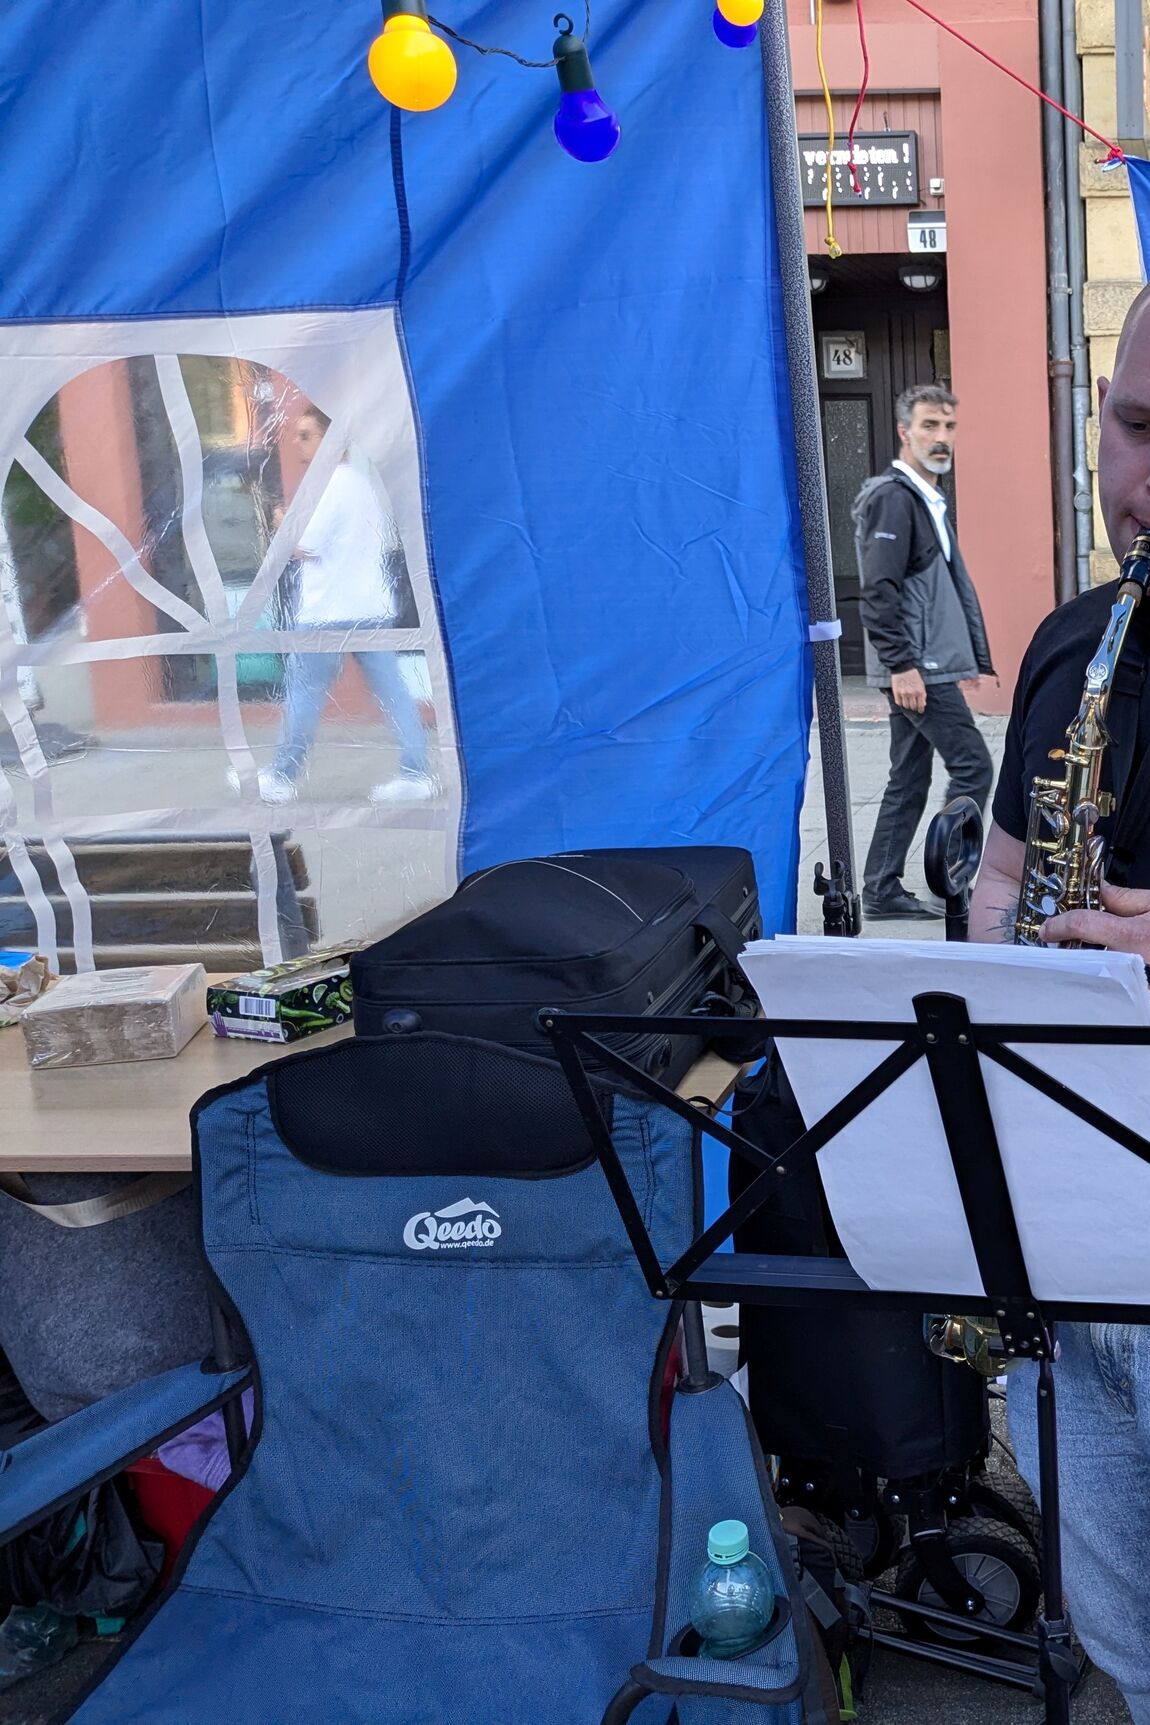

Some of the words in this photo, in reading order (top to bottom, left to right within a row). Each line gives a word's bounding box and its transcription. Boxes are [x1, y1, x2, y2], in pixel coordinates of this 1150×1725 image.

[919, 229, 937, 249] 48
[832, 348, 853, 366] 48
[403, 1212, 502, 1250] Qeedo
[440, 1239, 495, 1249] www.qeedo.de
